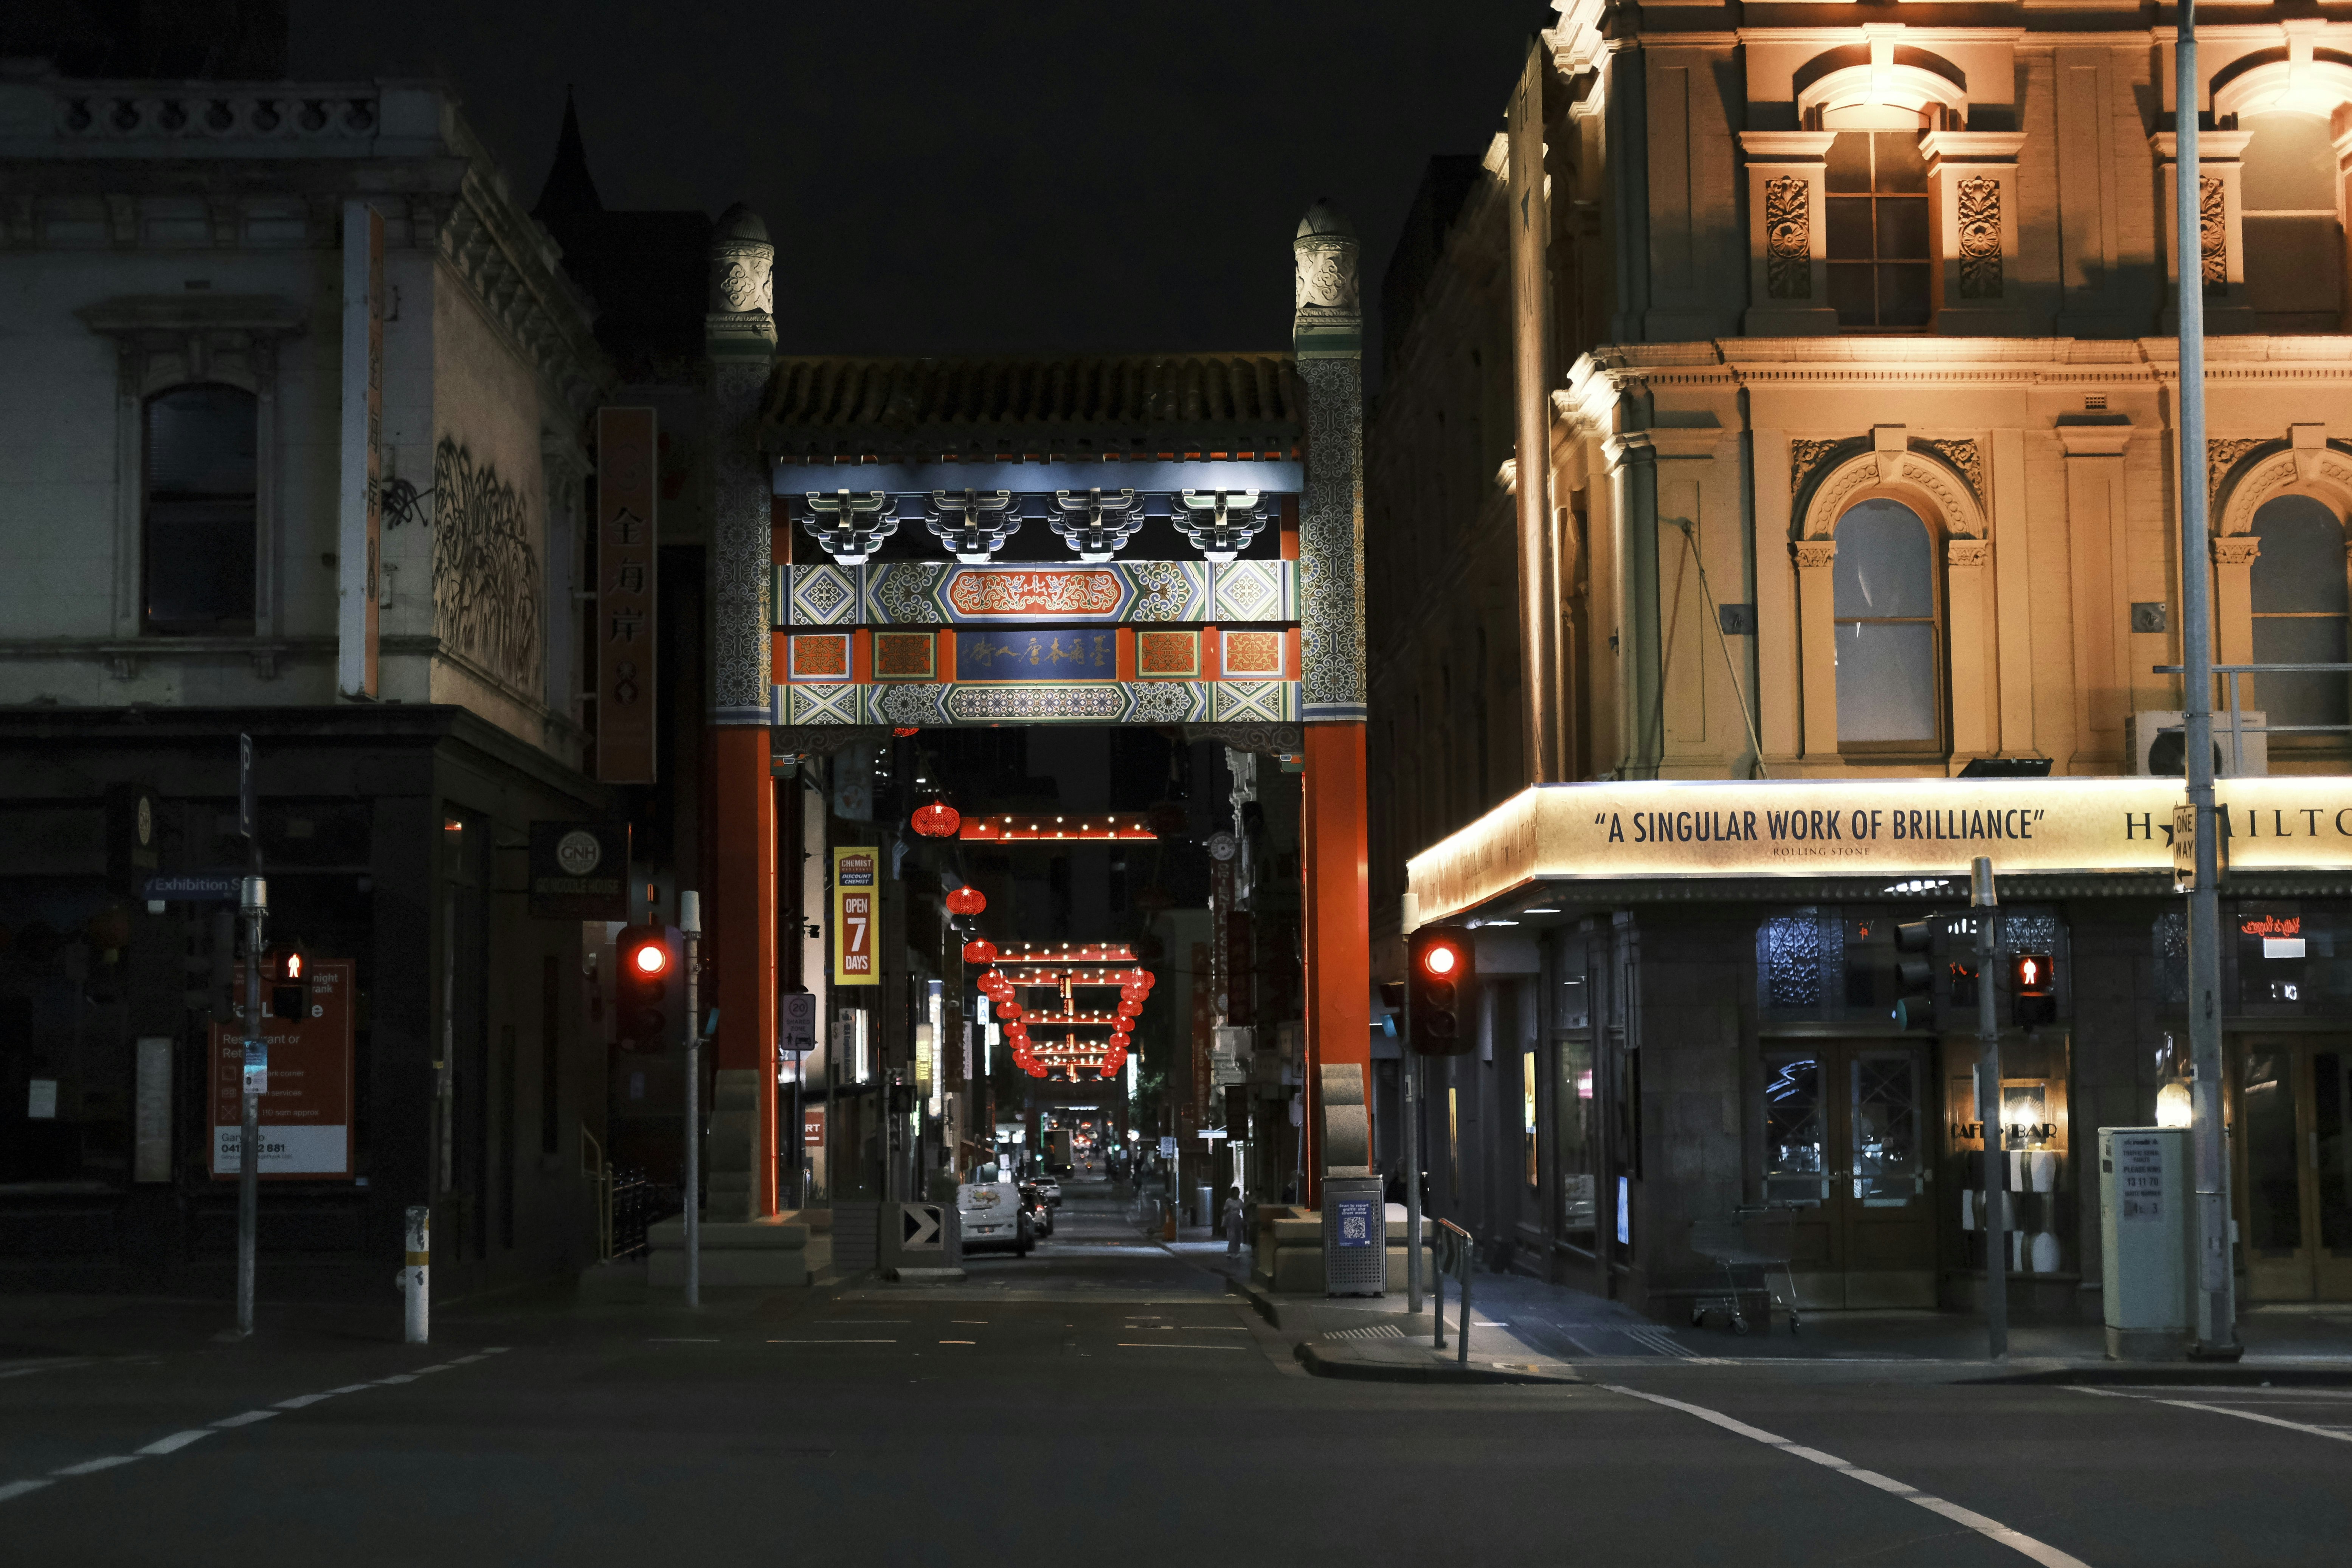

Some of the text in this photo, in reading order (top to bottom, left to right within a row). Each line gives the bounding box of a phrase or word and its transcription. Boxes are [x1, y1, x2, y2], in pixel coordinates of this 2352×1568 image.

[607, 506, 646, 643] 金海岸
[1633, 811, 1758, 842] SINGULAR
[1767, 810, 1842, 840] WORK
[1852, 810, 1882, 840] OF
[2176, 813, 2193, 834] ONE
[561, 846, 596, 860] GNH
[1773, 847, 1870, 856] ROLLING STONE
[2175, 839, 2194, 860] WAY
[155, 877, 242, 890] Exhibition S
[846, 898, 868, 913] OPEN
[847, 917, 866, 952] 7
[846, 955, 868, 970] DAYS
[313, 973, 338, 983] night
[312, 985, 333, 993] rank
[793, 1003, 805, 1012] 20
[288, 1036, 300, 1044] or
[223, 1048, 242, 1058] Ret
[919, 1041, 928, 1080] SEVEN STAR
[1198, 1070, 1205, 1081] OF
[805, 1124, 820, 1132] RT
[2011, 1123, 2057, 1138] BAR
[222, 1144, 242, 1152] 041
[267, 1144, 285, 1152] 881
[2127, 1177, 2158, 1186] 13 11 70
